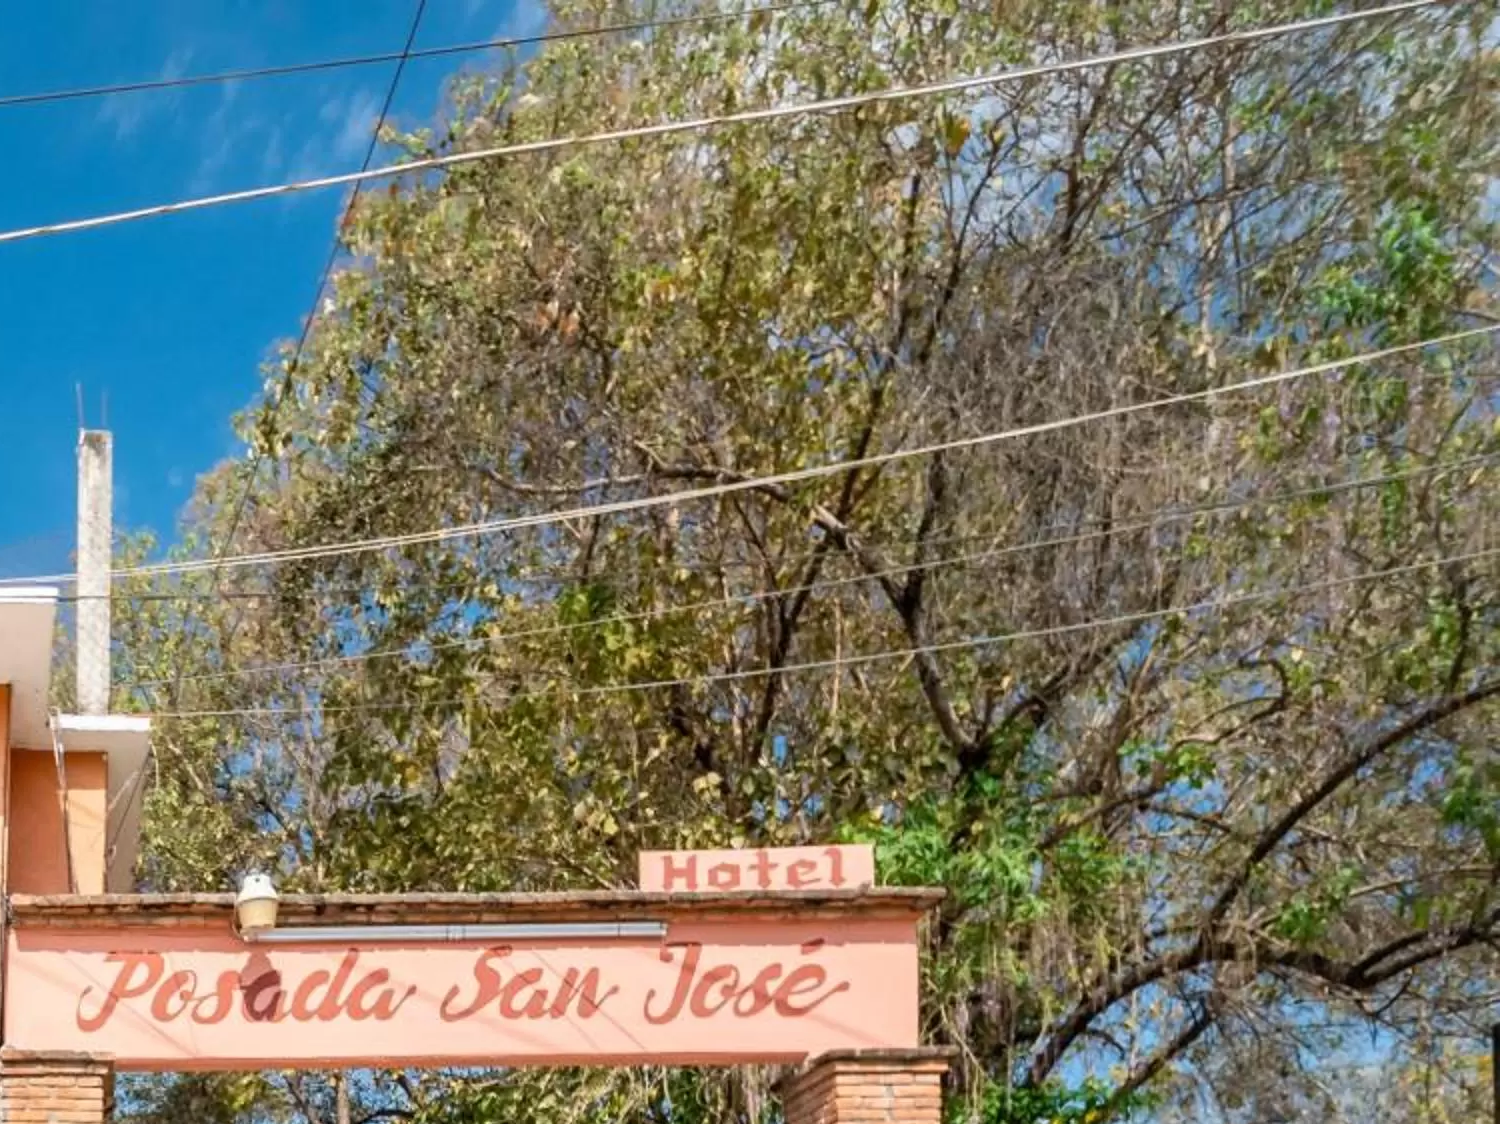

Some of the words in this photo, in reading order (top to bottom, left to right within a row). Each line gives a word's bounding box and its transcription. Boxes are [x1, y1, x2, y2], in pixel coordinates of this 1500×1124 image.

[660, 848, 846, 891] Hotel
[76, 948, 417, 1033] Posada
[440, 944, 620, 1023] San
[643, 937, 851, 1026] José
